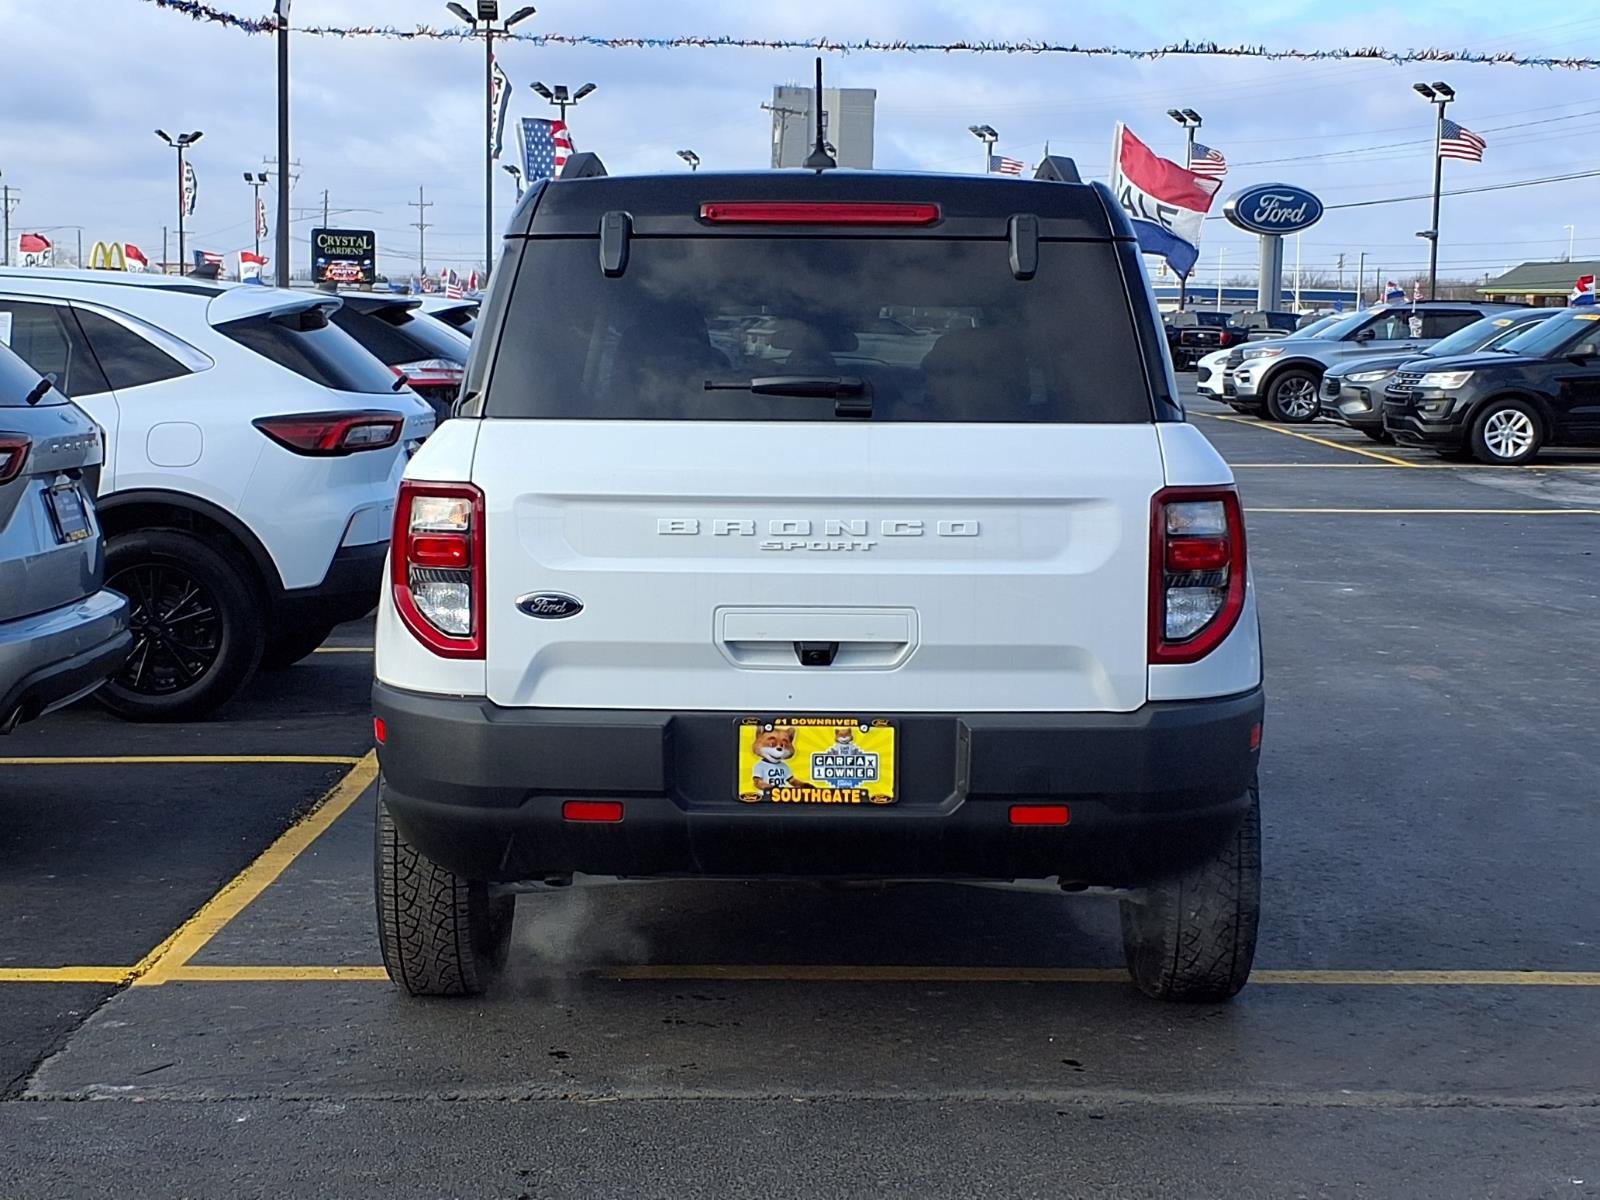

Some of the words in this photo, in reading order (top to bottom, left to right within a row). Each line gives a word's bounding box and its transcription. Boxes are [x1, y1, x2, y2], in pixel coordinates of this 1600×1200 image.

[1254, 194, 1307, 224] Ford
[317, 234, 372, 249] CRYSTAL
[324, 246, 364, 256] GARDENS
[657, 518, 981, 537] BRONCO
[759, 540, 877, 551] SPORT
[531, 597, 567, 613] Ford
[774, 718, 787, 726] #1
[791, 718, 858, 726] DOWNRIVER
[815, 756, 874, 767] CARFAX
[768, 768, 785, 777] CAR
[768, 778, 786, 786] FOX
[771, 788, 861, 803] SOUTHGATE
